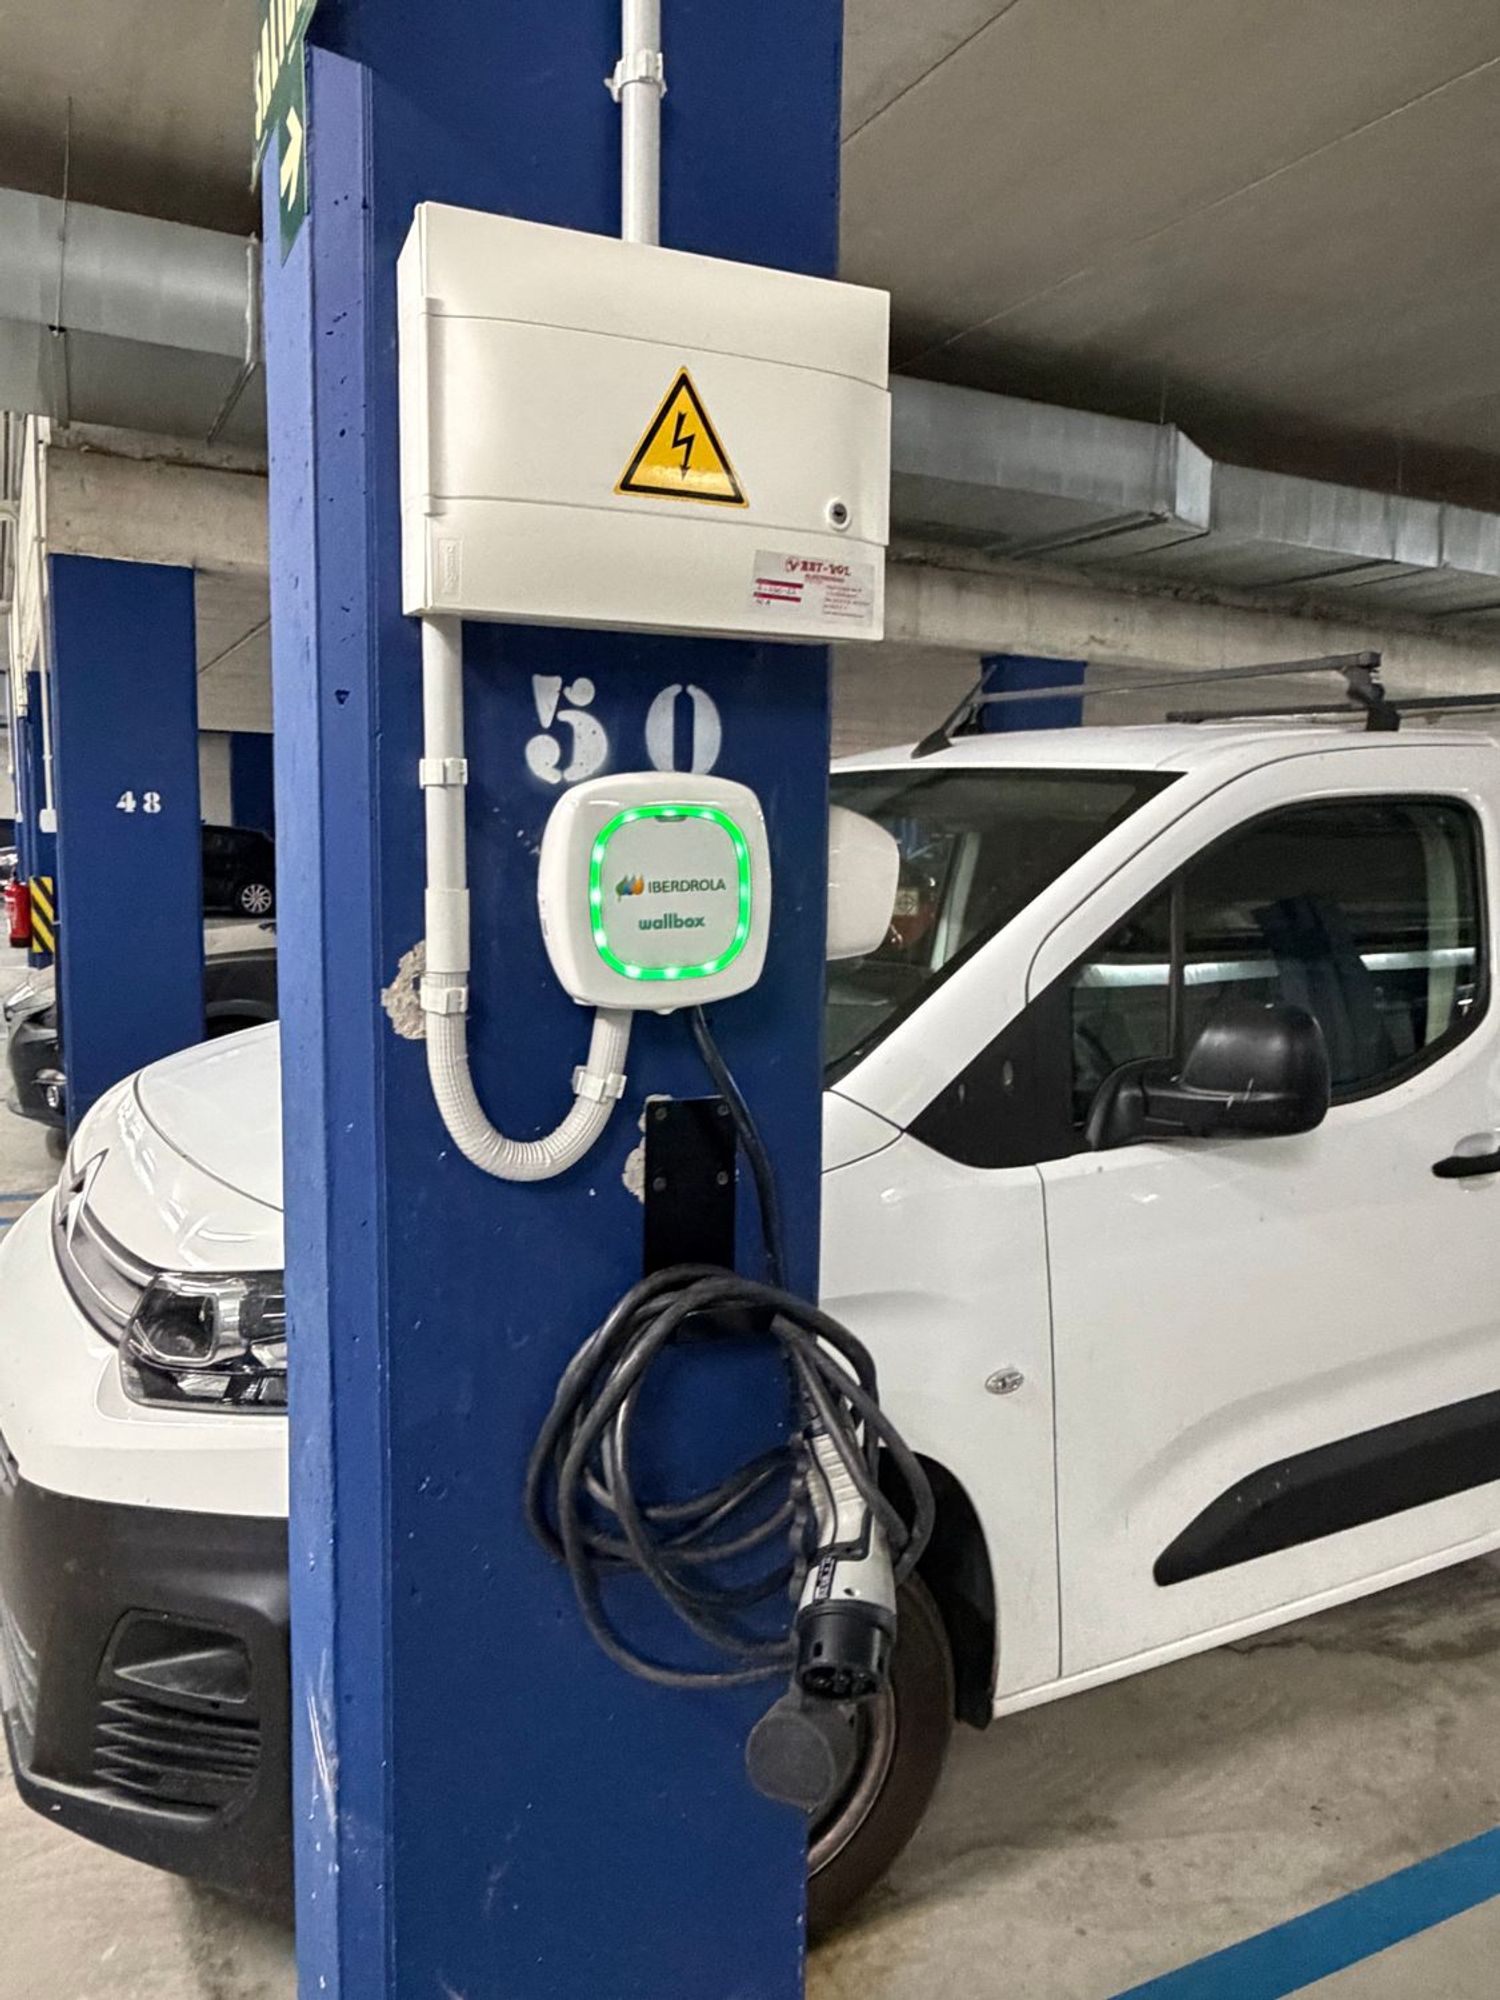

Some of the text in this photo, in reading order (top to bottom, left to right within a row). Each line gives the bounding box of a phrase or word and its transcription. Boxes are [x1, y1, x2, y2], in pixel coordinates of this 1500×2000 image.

[525, 674, 722, 784] 50
[116, 791, 161, 813] 48
[648, 879, 726, 893] IBERDROLA
[638, 913, 705, 930] wallbox
